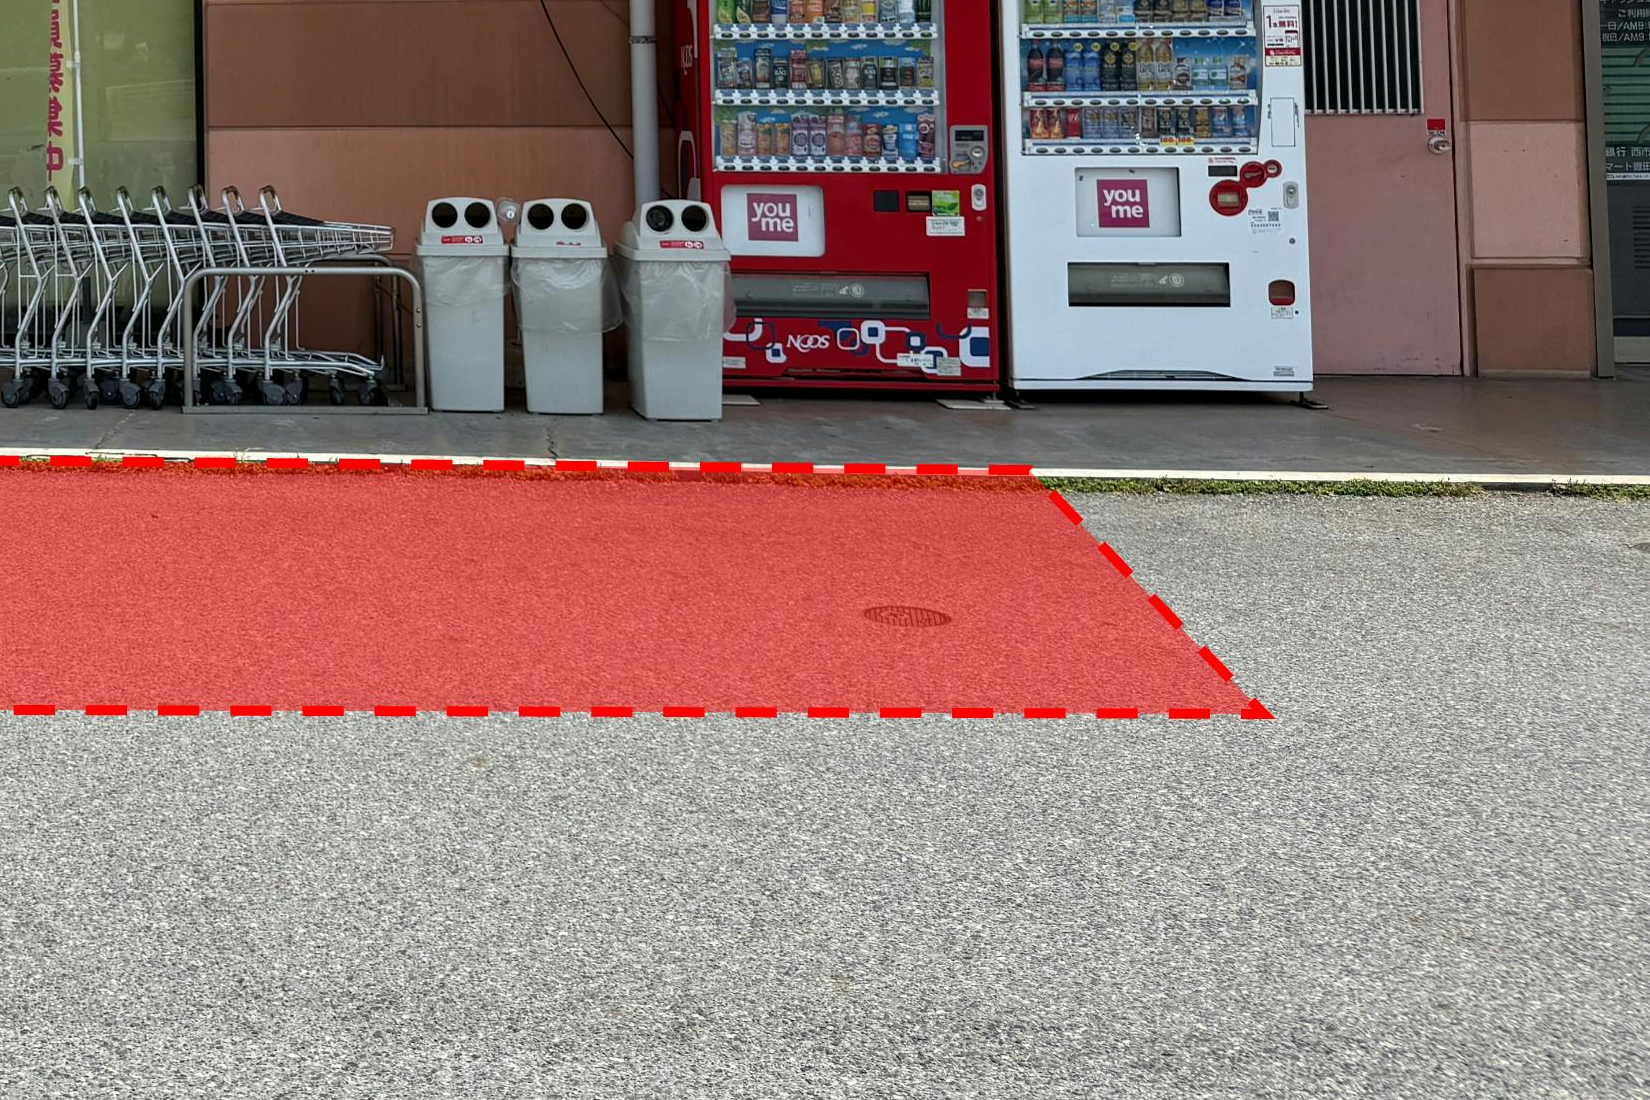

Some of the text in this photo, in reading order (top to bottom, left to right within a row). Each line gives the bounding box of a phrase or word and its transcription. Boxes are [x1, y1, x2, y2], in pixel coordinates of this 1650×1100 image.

[1102, 188, 1141, 207] you
[751, 201, 791, 223] you
[1111, 203, 1144, 219] me
[761, 218, 795, 233] me
